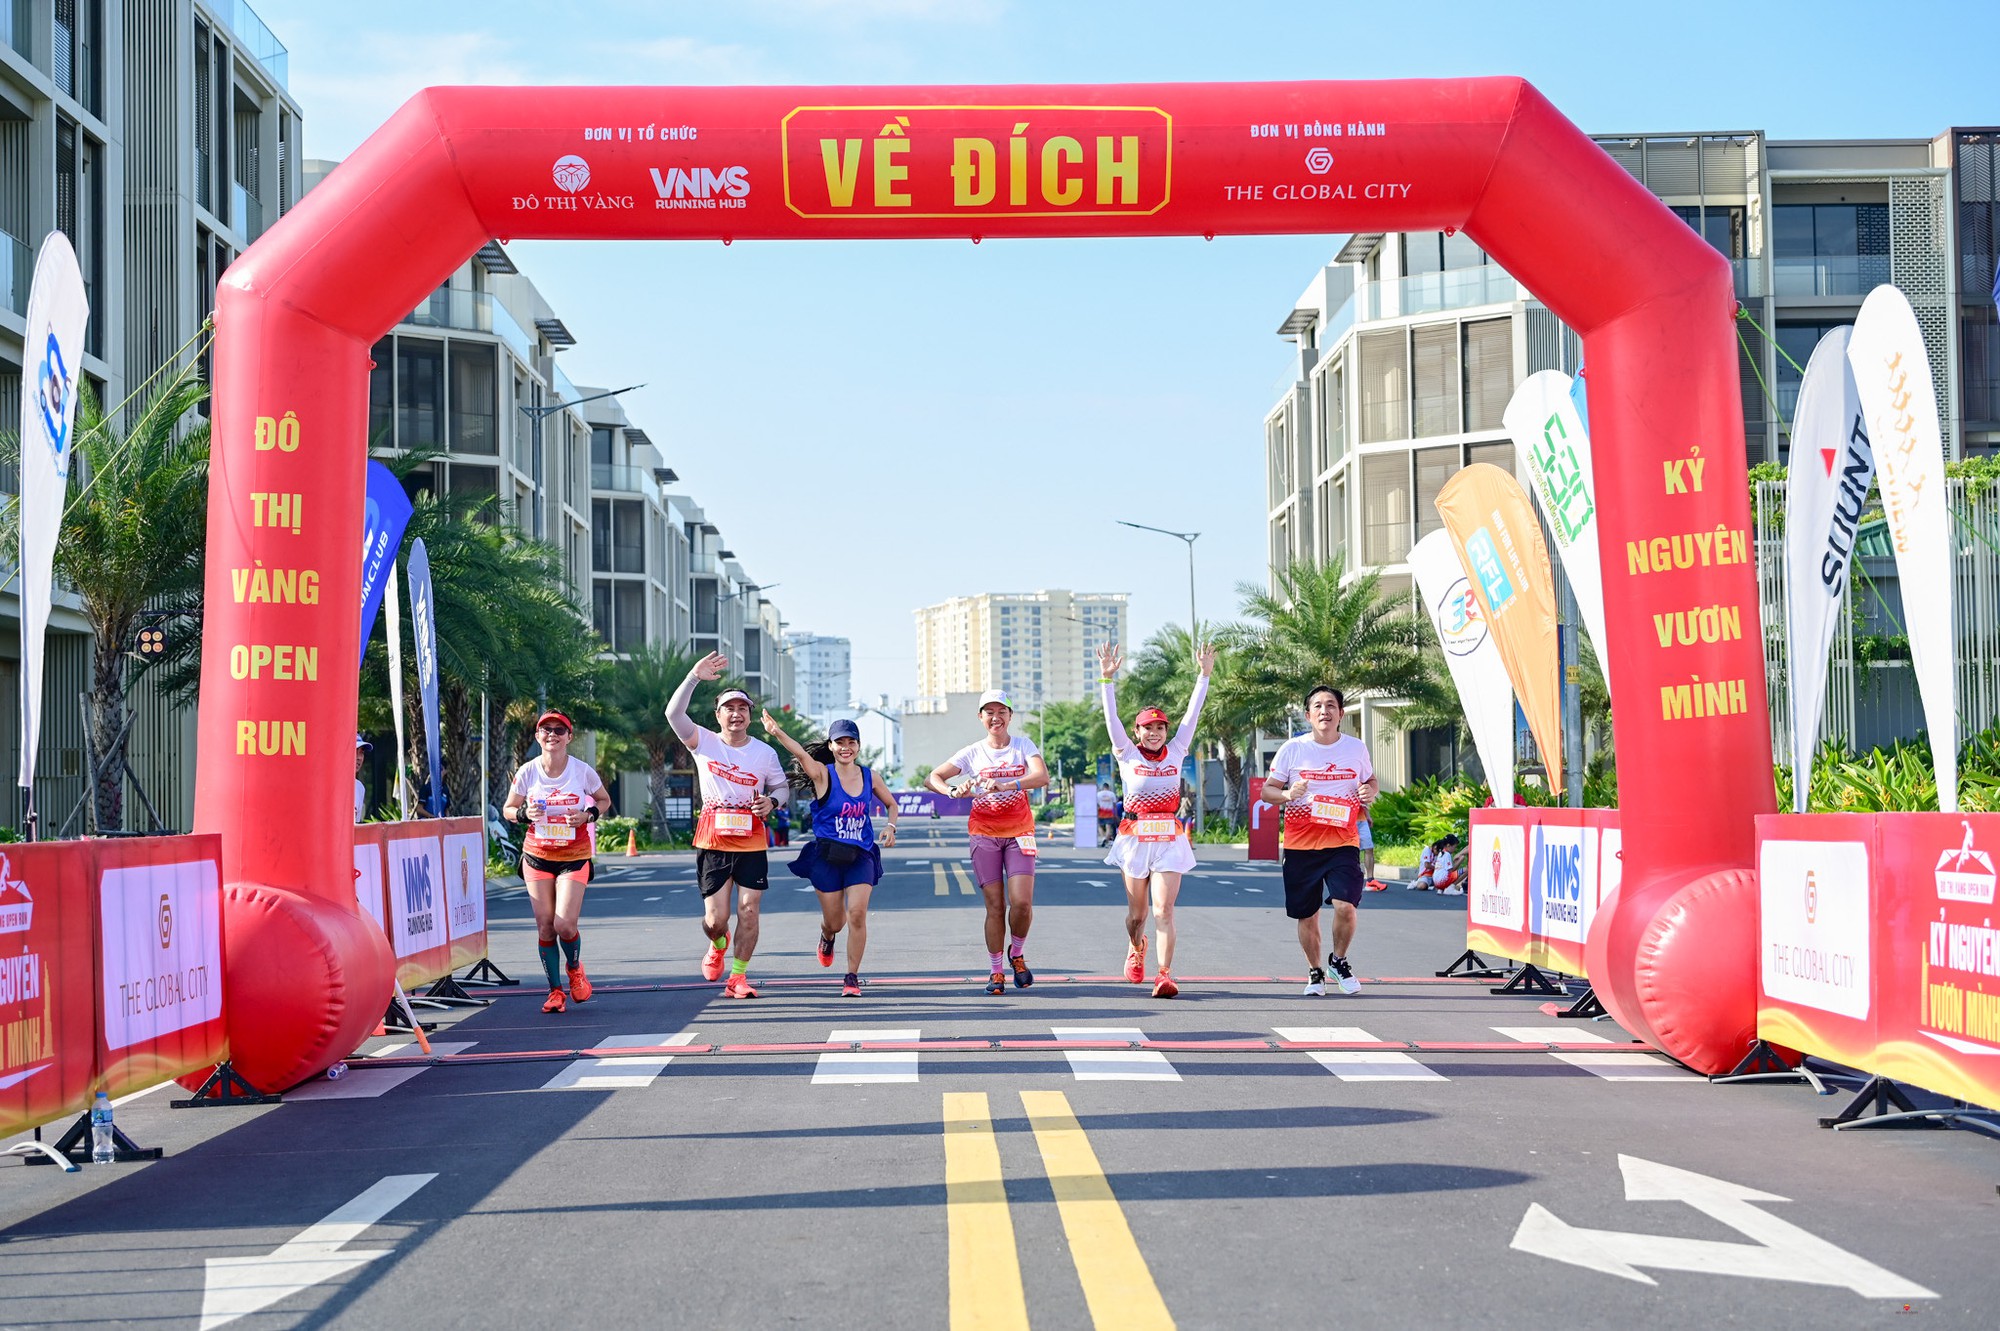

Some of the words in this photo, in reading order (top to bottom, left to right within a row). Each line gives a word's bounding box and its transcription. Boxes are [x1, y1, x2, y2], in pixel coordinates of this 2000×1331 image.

[584, 126, 613, 142] ĐƠN
[618, 126, 632, 143] VỊ
[638, 122, 656, 142] TỔ
[660, 123, 698, 141] CHỨC
[1250, 123, 1280, 138] ĐƠN
[1284, 123, 1299, 140] VỊ
[1303, 120, 1341, 138] ĐỒNG
[1347, 120, 1386, 137] HÀNH
[649, 165, 750, 199] VNMS
[819, 116, 912, 208] VỀ
[950, 122, 1139, 208] ĐÍCH
[512, 195, 541, 210] ĐÔ
[544, 196, 578, 212] THỊ
[581, 191, 635, 210] VÀNG
[655, 198, 717, 210] RUNNING
[719, 198, 747, 209] HUB
[1224, 185, 1263, 201] THE
[1271, 184, 1357, 201] GLOBAL
[1363, 183, 1412, 199] CITY
[254, 410, 301, 453] ĐÔ
[1663, 445, 1705, 495] KỶ
[250, 492, 302, 535] THỊ
[1822, 400, 1873, 598] SUUNT
[368, 531, 389, 583] CLUB
[1470, 537, 1504, 602] RFL
[1626, 523, 1748, 576] NGUYÊN
[231, 559, 319, 605] VÀNG
[1516, 566, 1530, 593] CLUB
[1653, 604, 1742, 648] VƯƠN
[230, 644, 318, 681] OPEN
[1660, 674, 1748, 721] MÌNH
[236, 720, 306, 757] RUN
[1142, 821, 1171, 833] 21057
[402, 854, 432, 913] VNMS
[1545, 844, 1580, 901] VNMS
[1930, 907, 1947, 967] KỶ
[1773, 943, 1789, 975] THE
[1793, 947, 1830, 984] GLOBAL
[1833, 953, 1856, 989] CITY
[120, 982, 141, 1018] THE
[145, 970, 186, 1011] GLOBAL
[189, 965, 210, 998] CITY
[1930, 981, 1963, 1034] VƯƠN
[7, 1010, 41, 1068] MÌNH
